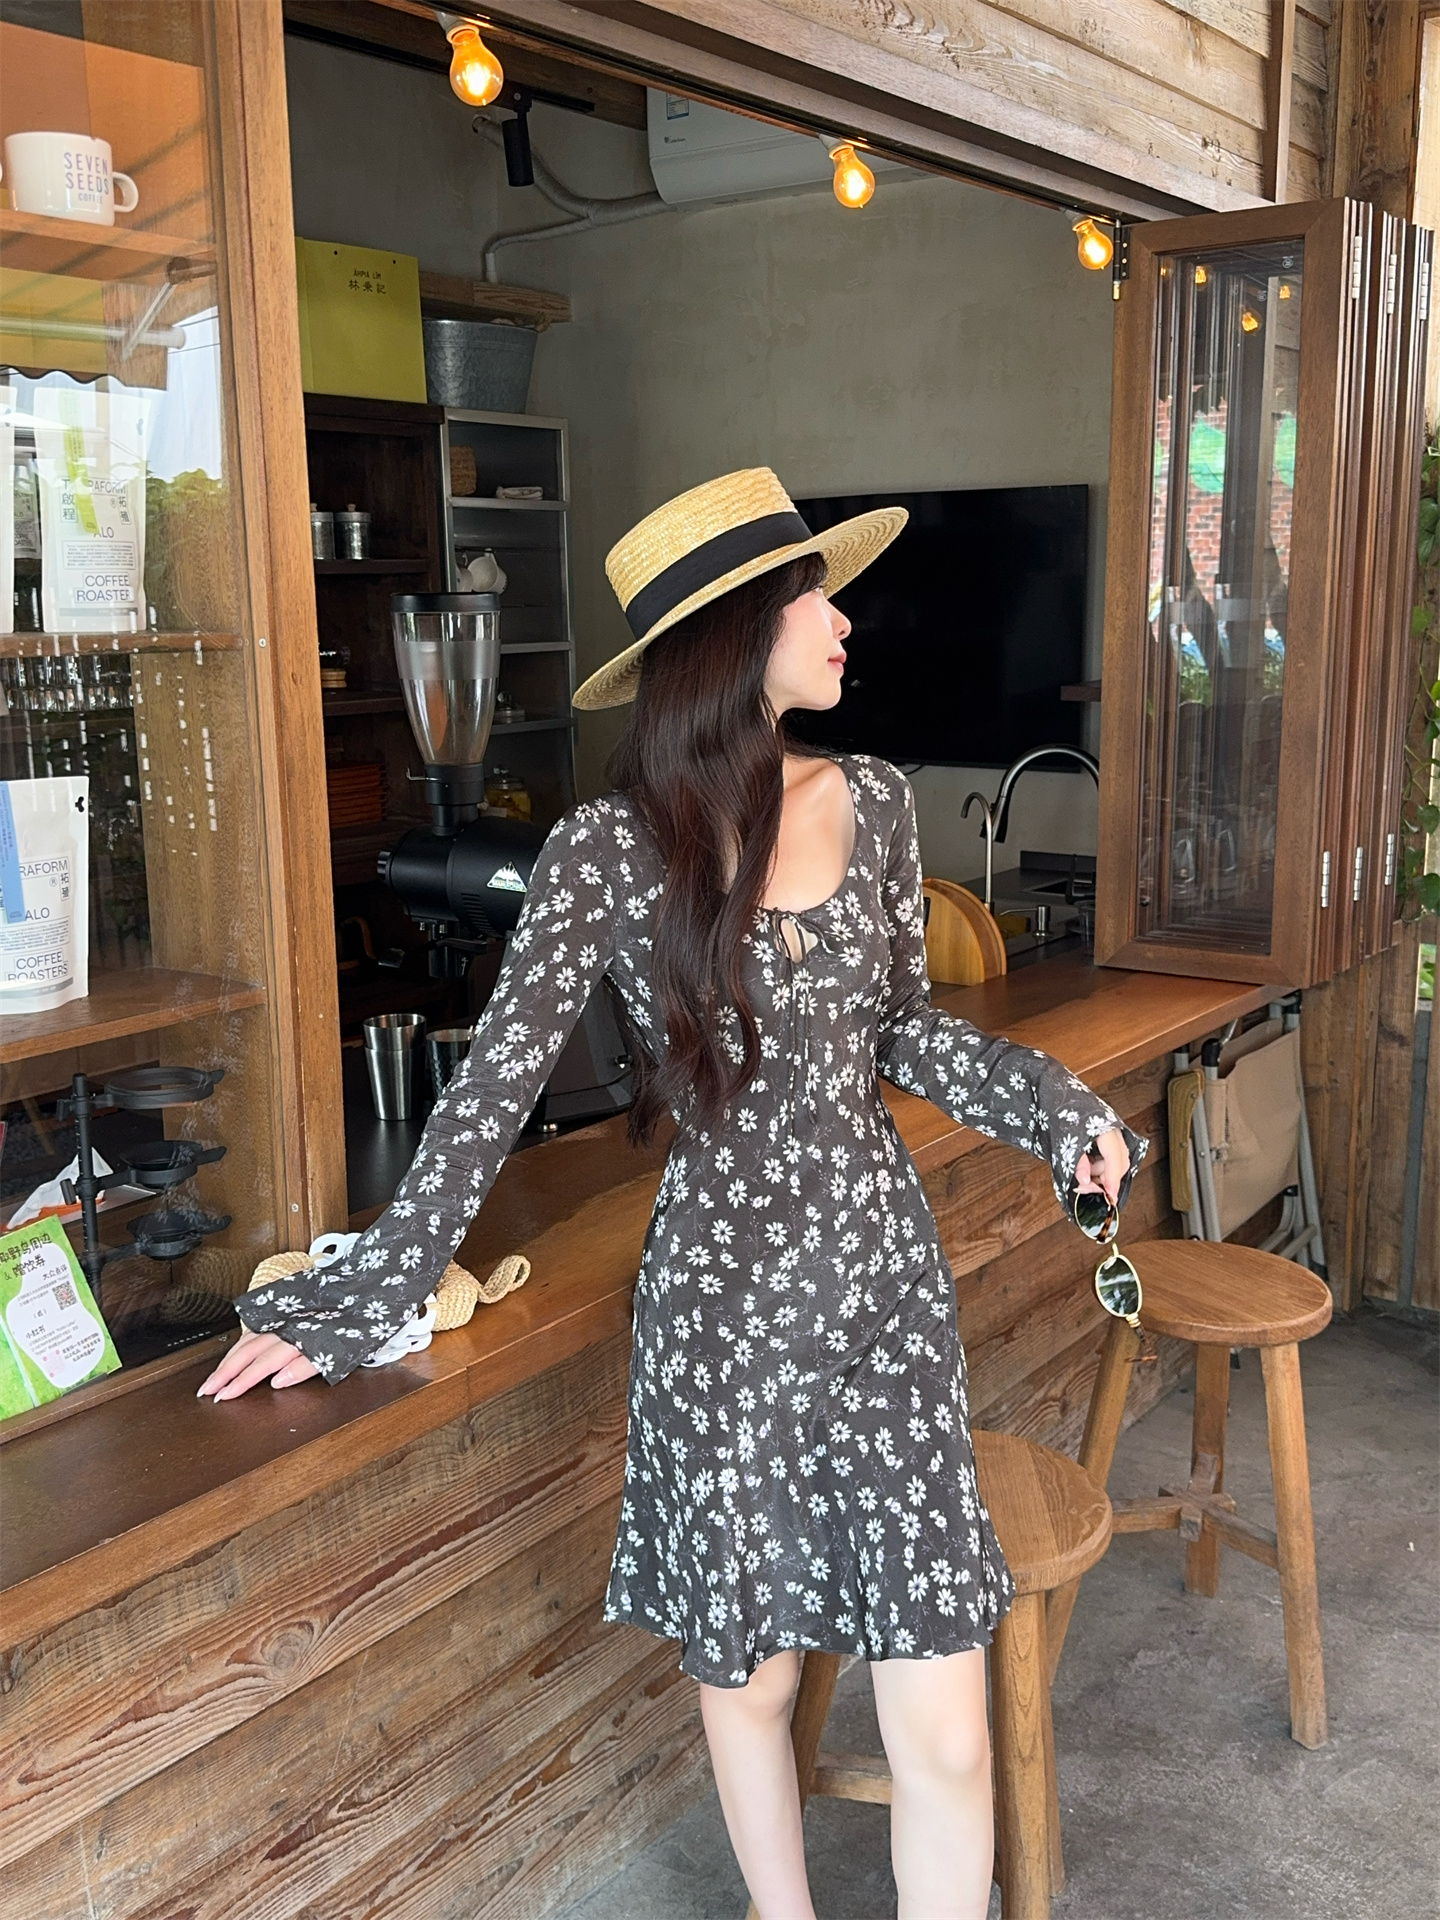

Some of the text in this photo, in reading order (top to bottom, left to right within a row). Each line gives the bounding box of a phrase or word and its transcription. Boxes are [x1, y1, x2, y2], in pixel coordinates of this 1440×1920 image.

[64, 152, 108, 176] SEVEN
[65, 172, 109, 195] SEEDS
[85, 575, 130, 587] COFFEE
[76, 590, 133, 602] ROASTER
[16, 951, 63, 970] COFFEE
[7, 963, 69, 983] ROASTERS
[12, 1254, 46, 1278] 赠饮券
[42, 1264, 68, 1281] 大众点评
[26, 1324, 46, 1339] 小红书
